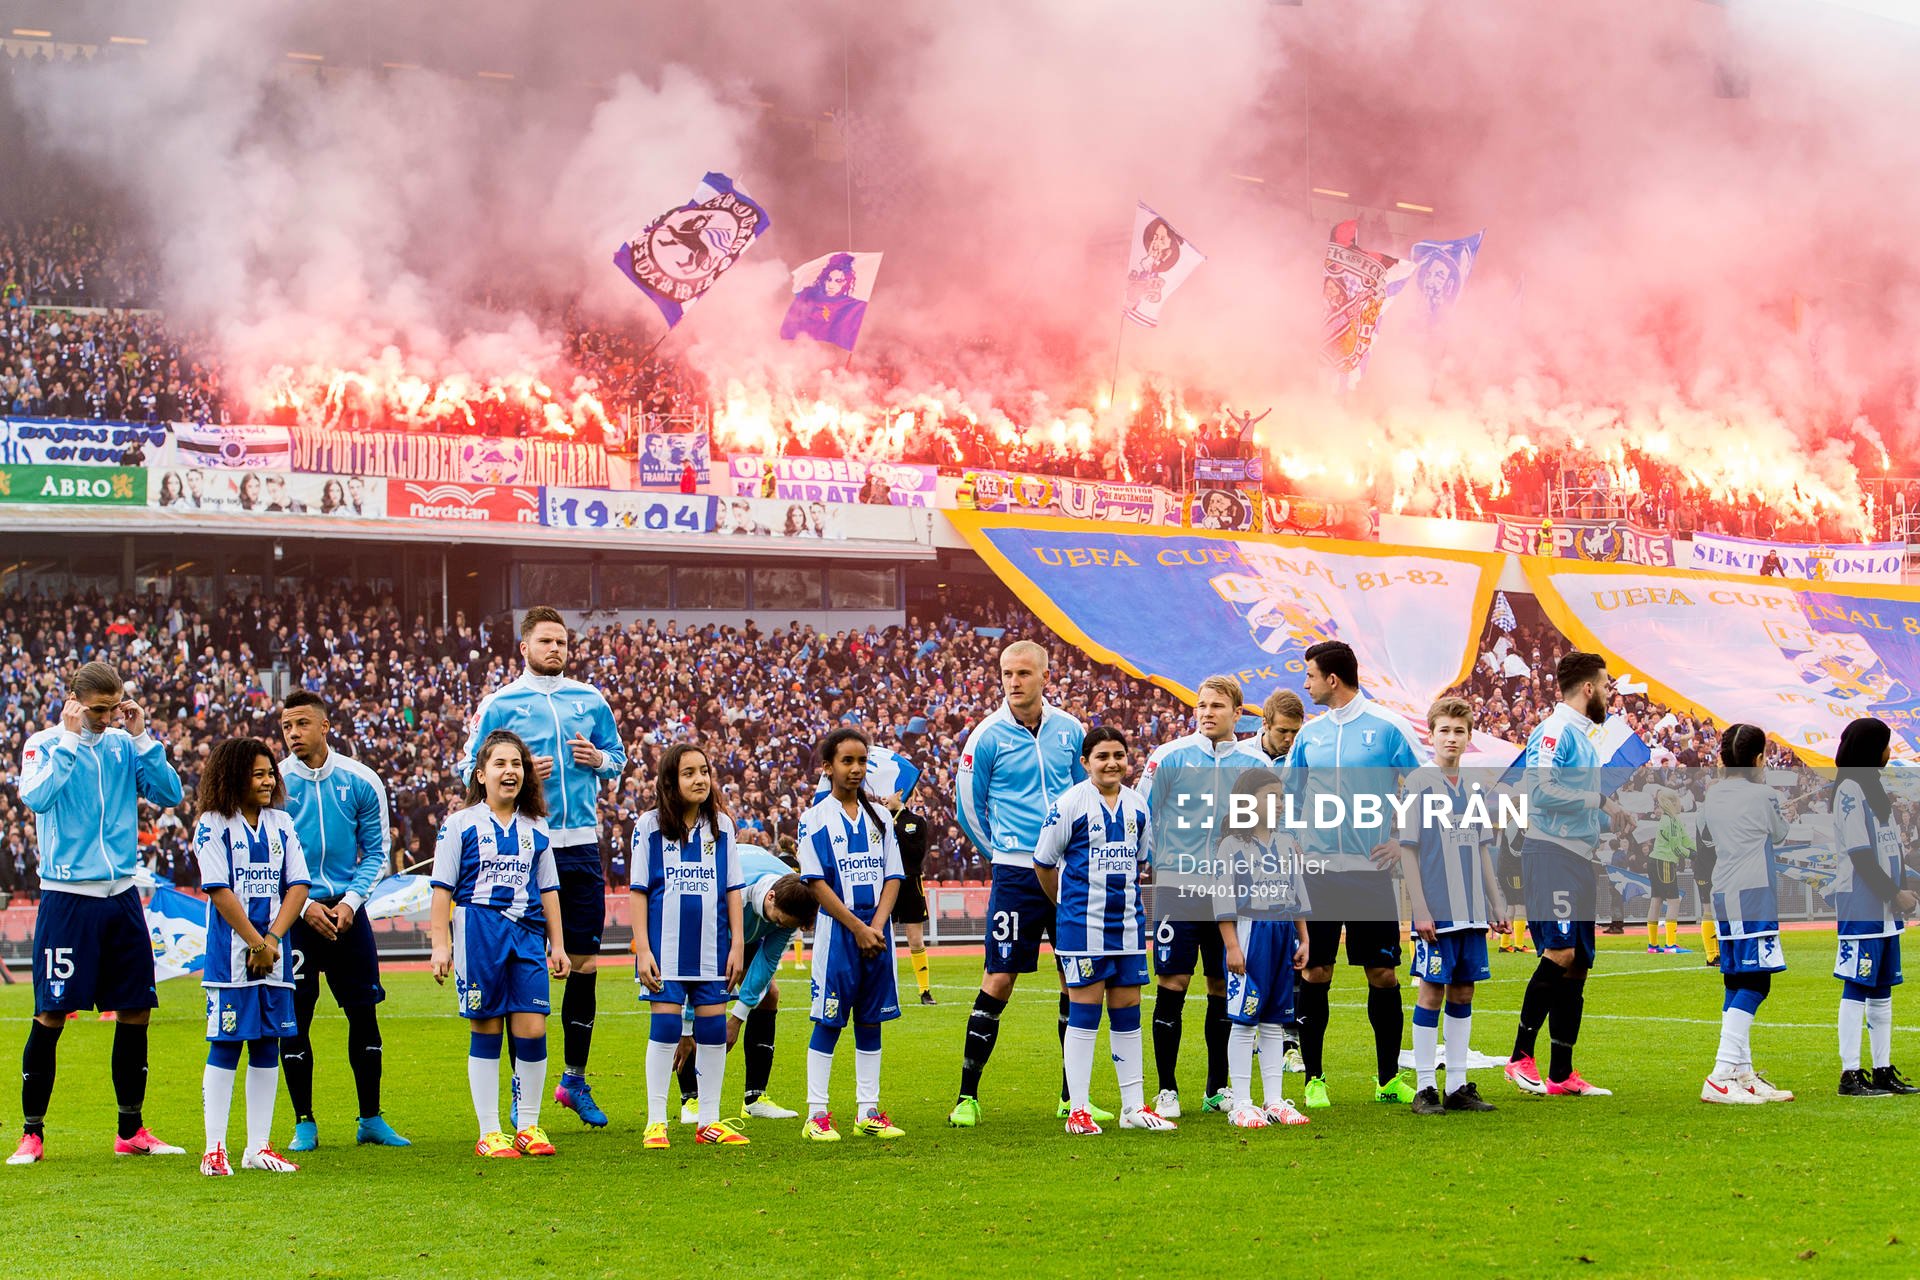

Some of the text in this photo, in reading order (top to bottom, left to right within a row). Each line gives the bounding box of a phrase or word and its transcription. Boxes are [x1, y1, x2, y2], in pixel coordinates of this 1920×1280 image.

[410, 502, 490, 521] nordstan
[1032, 547, 1141, 567] UEFA
[1354, 568, 1449, 592] 81-82
[1833, 556, 1901, 573] OSLO
[1591, 587, 1696, 611] UEFA
[1708, 590, 1780, 610] CUP
[55, 864, 72, 880] 15
[481, 858, 531, 874] Prioritet
[665, 865, 715, 880] Prioritet
[1097, 858, 1132, 871] Finans
[235, 867, 281, 881] Priorite
[485, 870, 523, 886] Finans
[672, 878, 709, 892] Finans
[1552, 890, 1572, 919] 5
[992, 911, 1019, 942] 31
[1156, 914, 1175, 944] 6
[44, 947, 75, 980] 15
